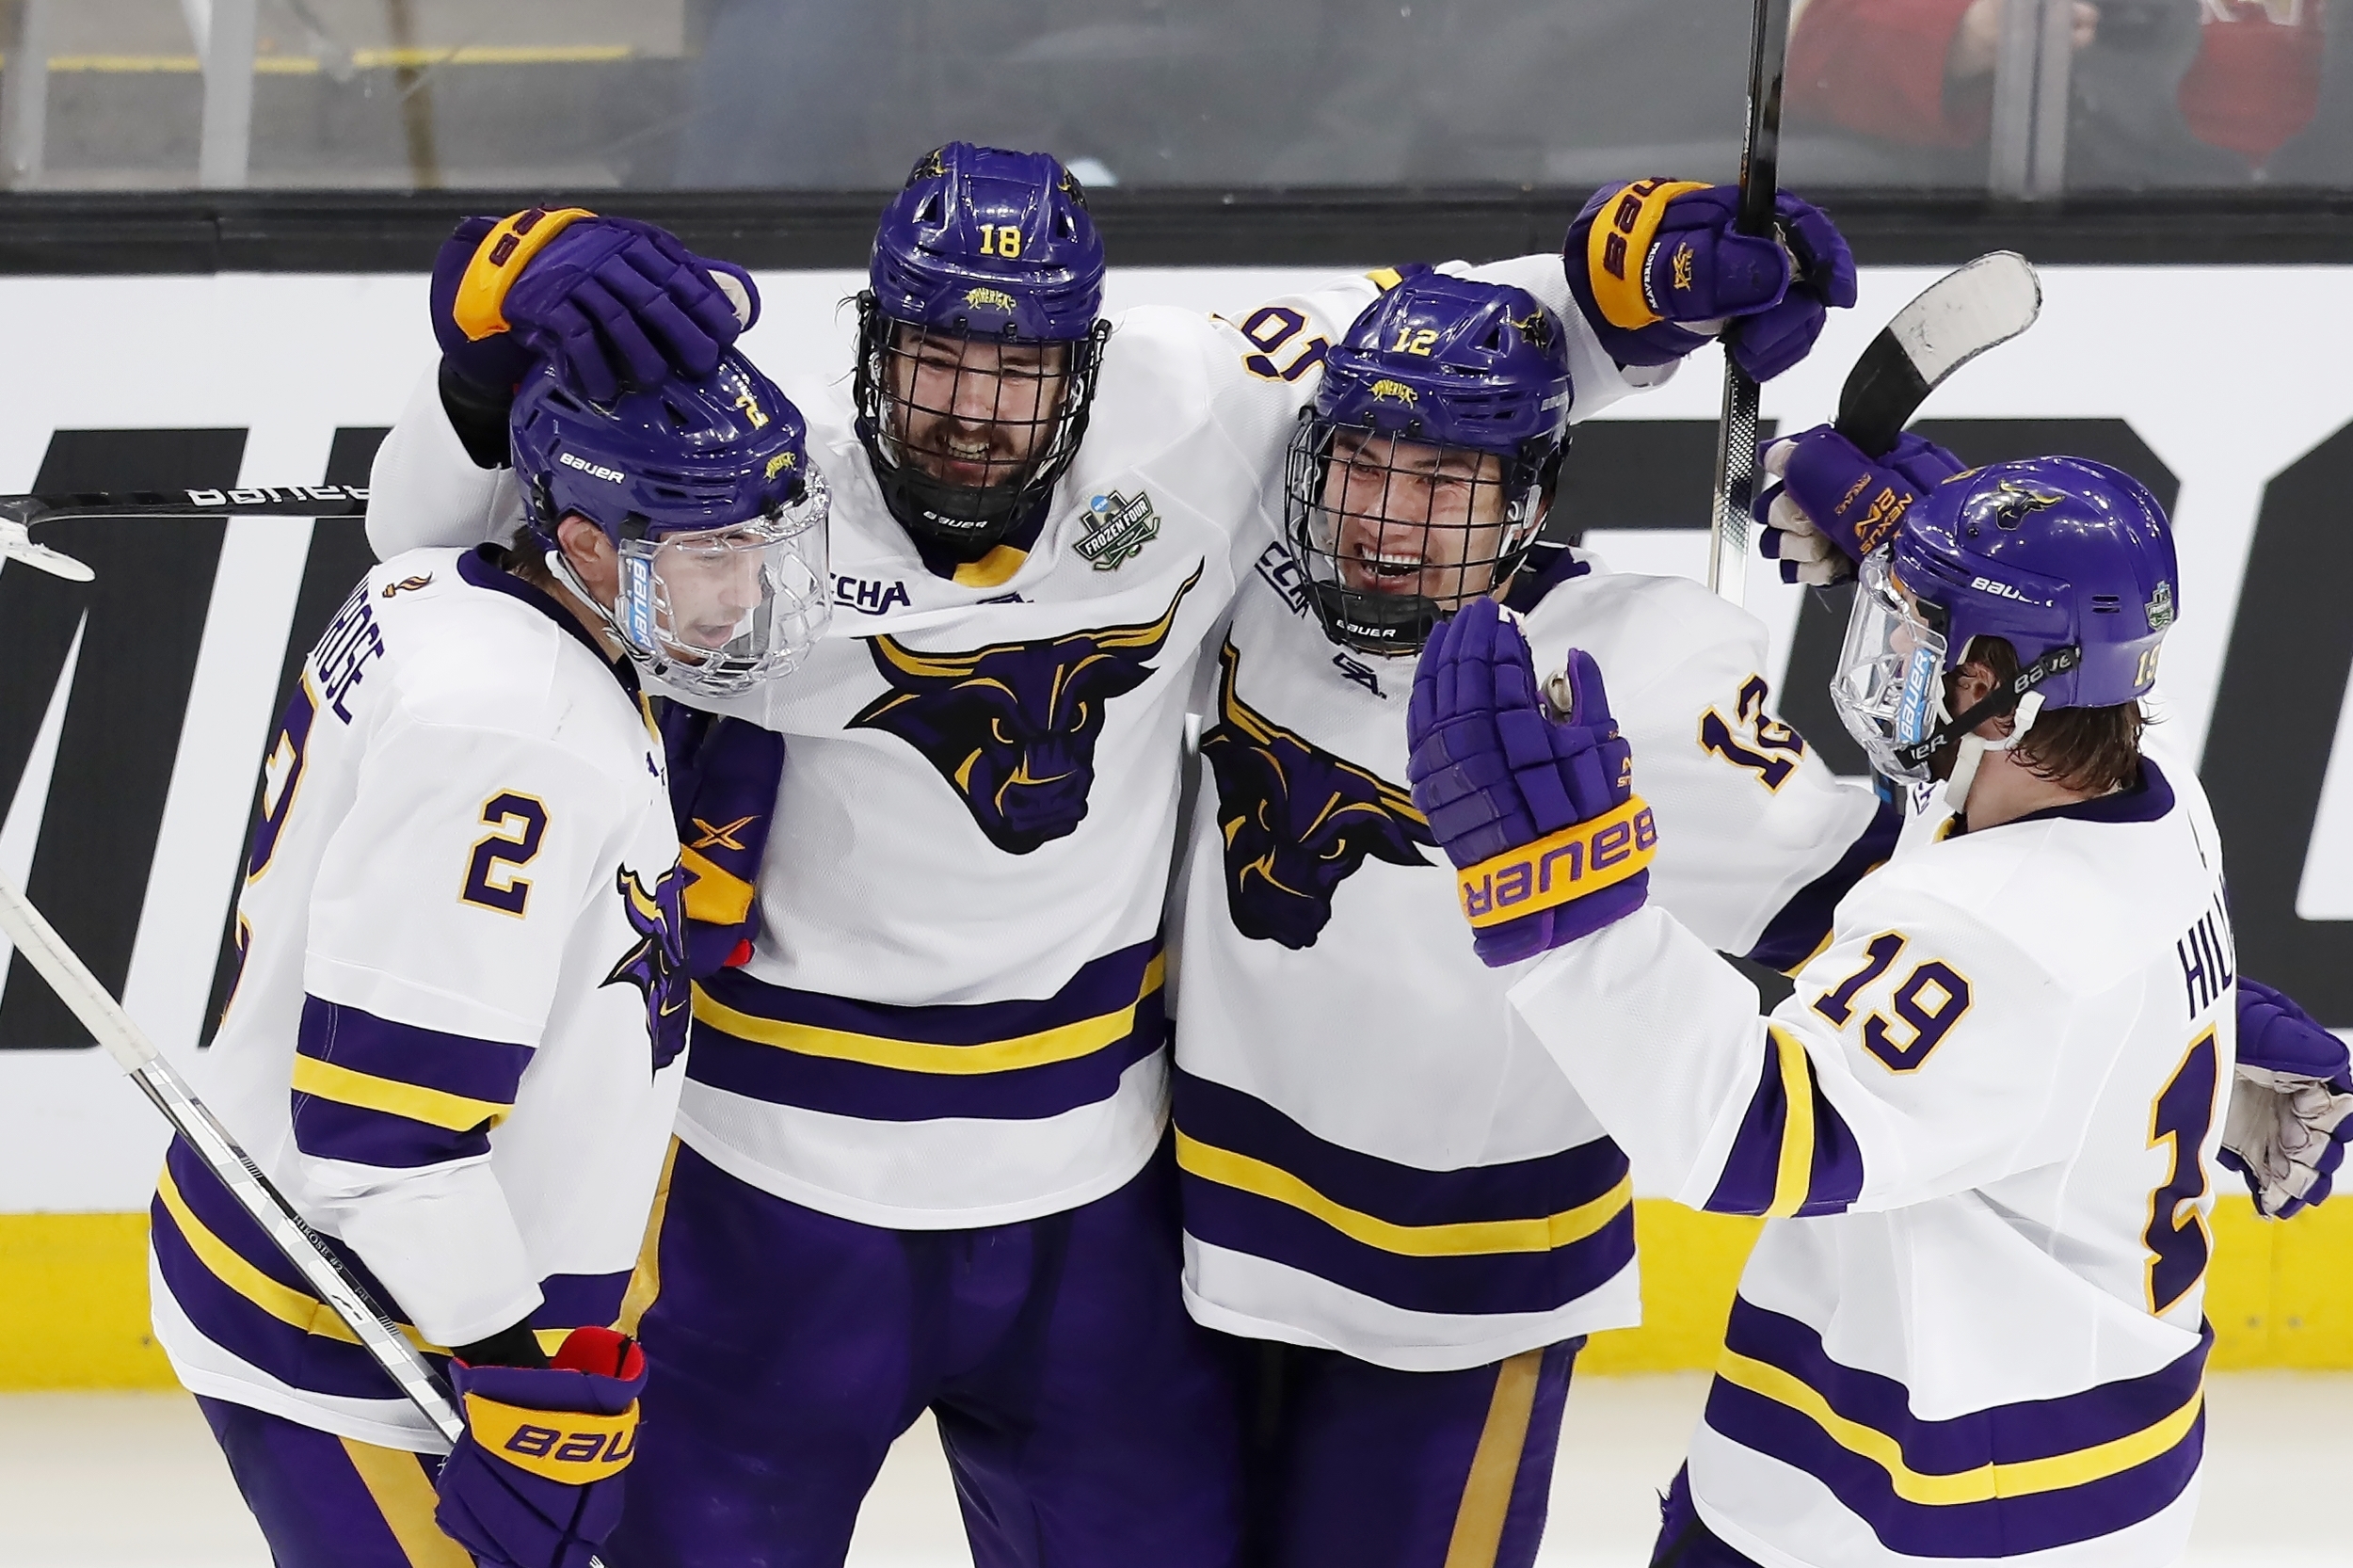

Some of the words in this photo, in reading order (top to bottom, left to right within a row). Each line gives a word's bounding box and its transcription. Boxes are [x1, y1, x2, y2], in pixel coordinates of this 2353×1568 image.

[979, 223, 1021, 259] 18
[1391, 327, 1438, 357] 12
[1084, 519, 1126, 555] FROZEN
[1123, 499, 1149, 527] FOUR
[1859, 492, 1914, 555] NEXUS
[829, 573, 911, 616] CHA
[2133, 644, 2161, 688] 19
[1697, 672, 1808, 795] 12
[459, 787, 552, 920] 2
[1811, 930, 1975, 1076] 19
[293, 1215, 329, 1257] HIROSE
